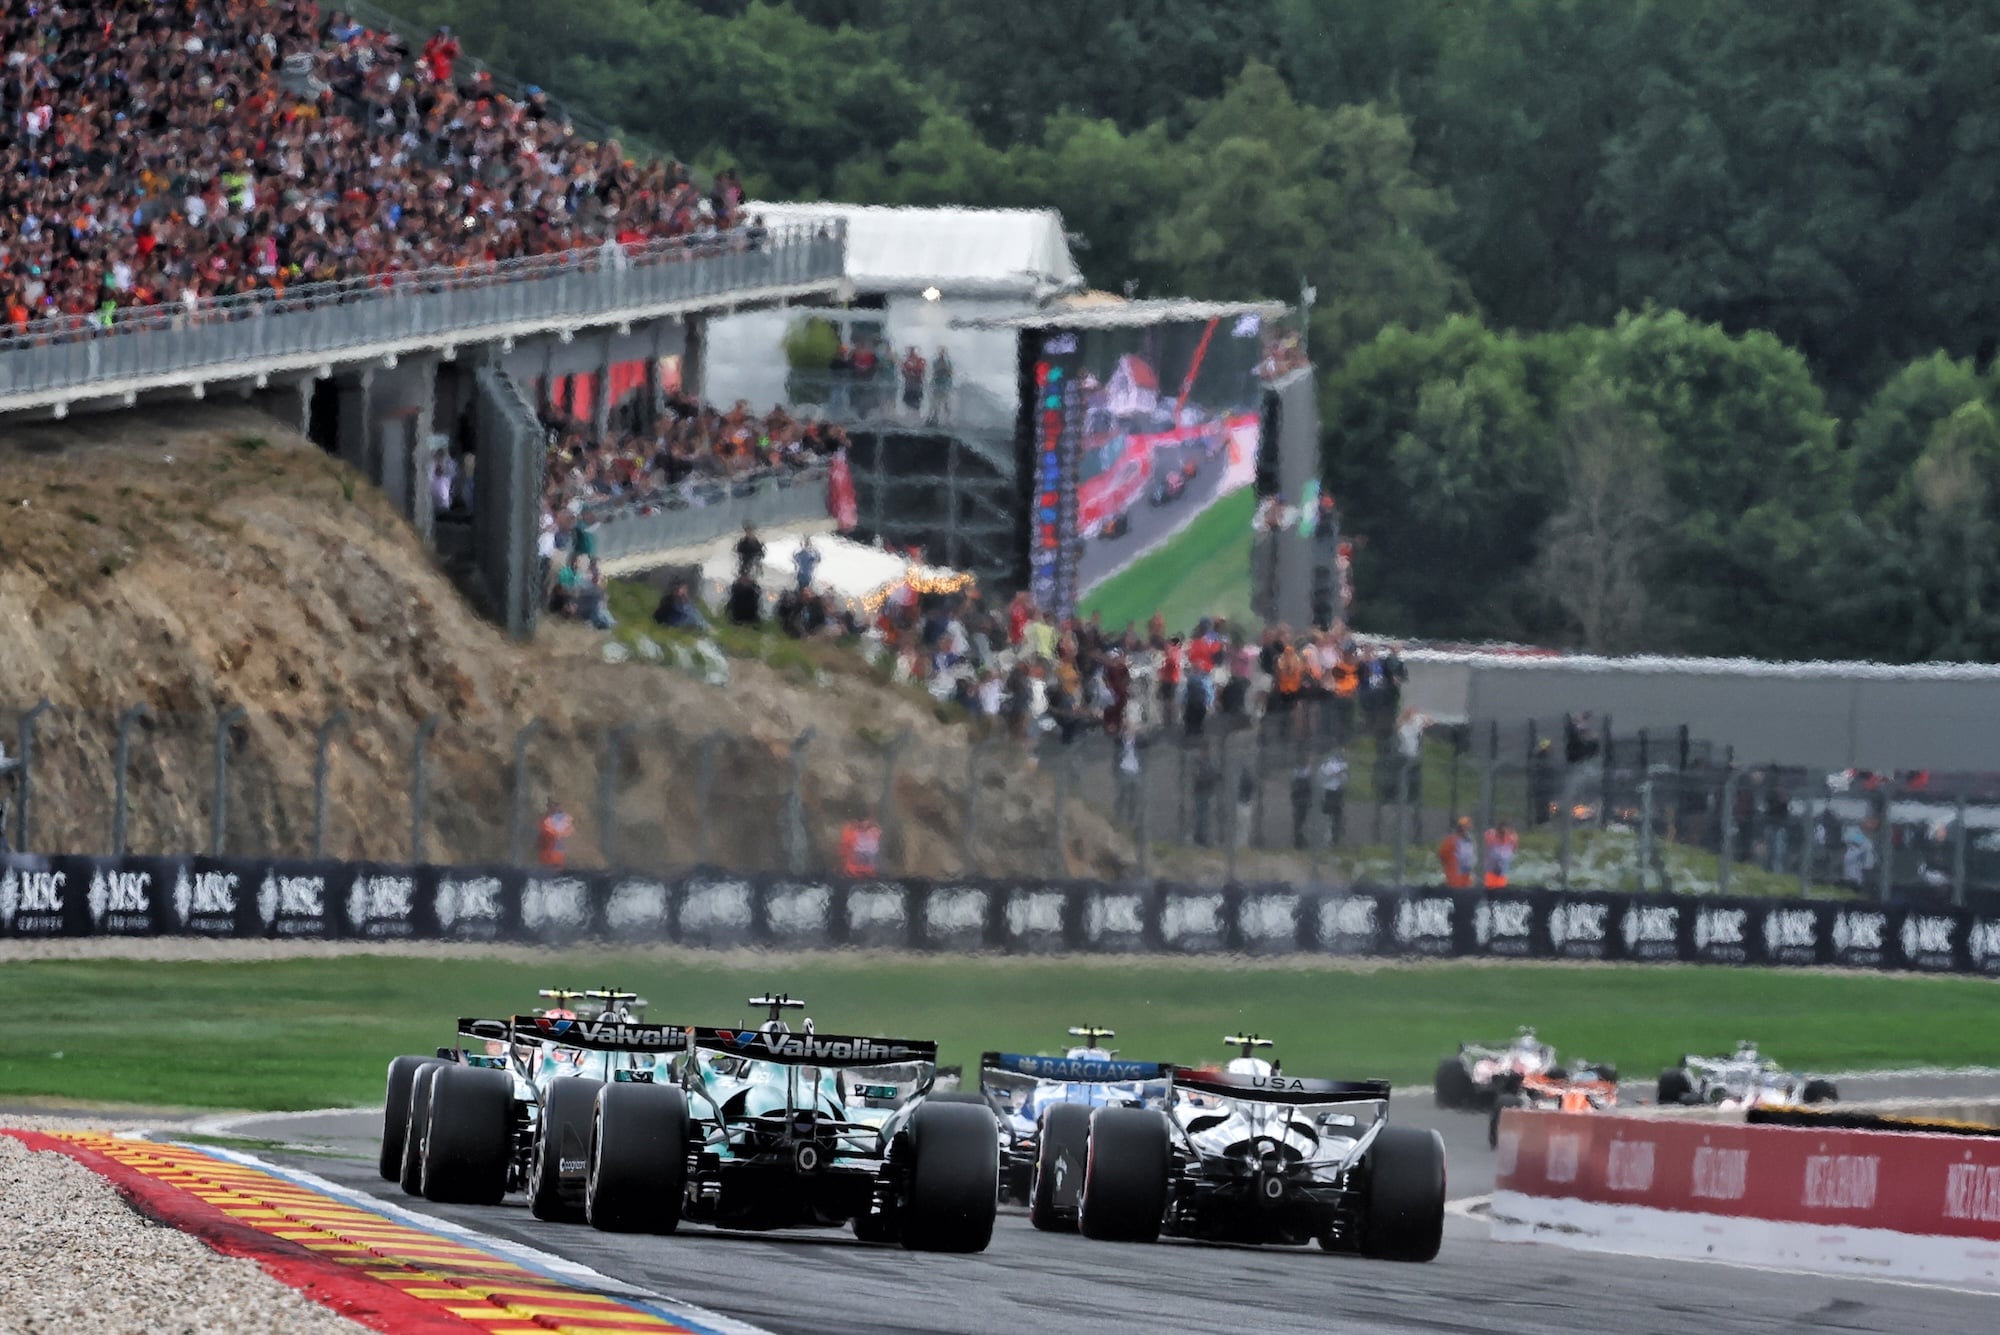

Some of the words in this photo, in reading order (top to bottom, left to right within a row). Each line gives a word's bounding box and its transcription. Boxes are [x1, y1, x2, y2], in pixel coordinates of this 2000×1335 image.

[763, 1033, 909, 1060] Valvoline
[1042, 1060, 1142, 1080] BARCLAYS
[1252, 1076, 1305, 1091] USA
